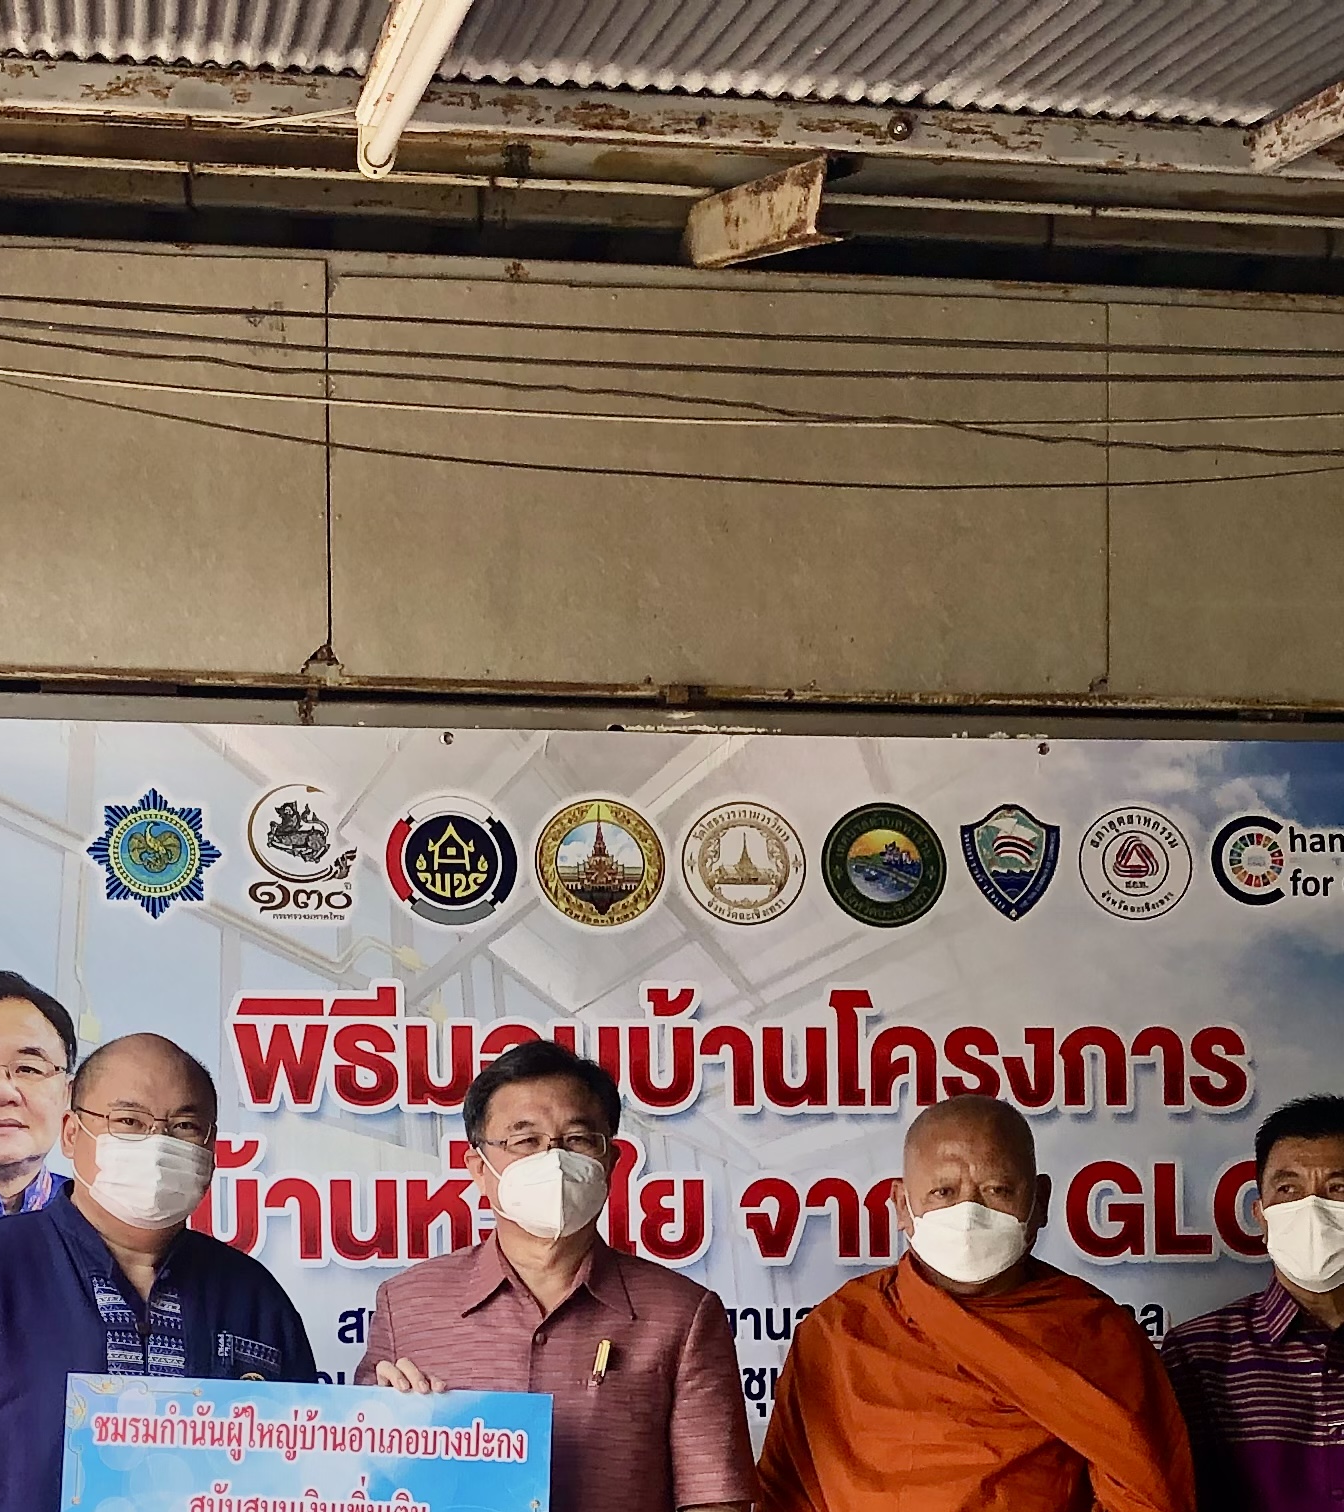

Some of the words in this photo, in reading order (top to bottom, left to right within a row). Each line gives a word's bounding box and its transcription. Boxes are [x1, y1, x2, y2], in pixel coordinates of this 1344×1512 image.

[1290, 868, 1334, 896] for
[93, 1404, 525, 1463] ชมรมกำนันผู้ใหญ่บ้านอำเภอบางปะกง
